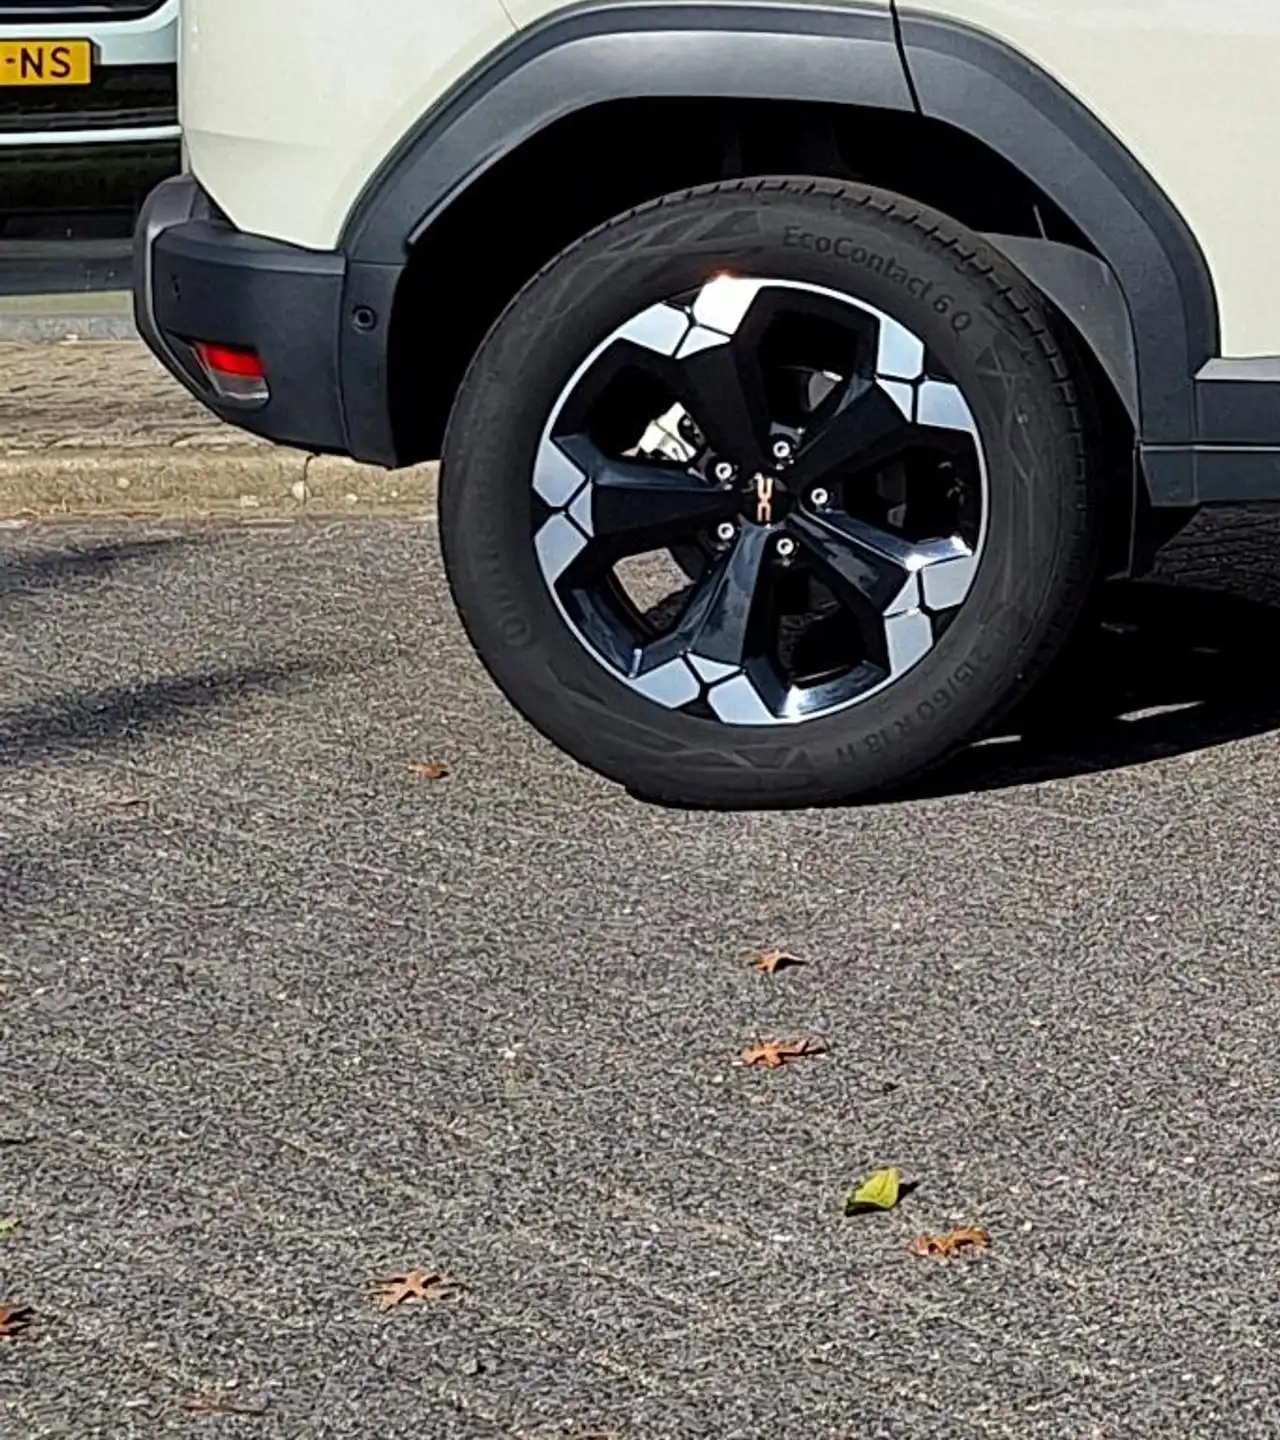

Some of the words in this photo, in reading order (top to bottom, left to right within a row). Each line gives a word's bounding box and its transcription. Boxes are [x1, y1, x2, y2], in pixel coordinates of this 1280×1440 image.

[783, 225, 934, 300] EcoContact
[932, 294, 955, 314] 6
[951, 311, 973, 341] Q
